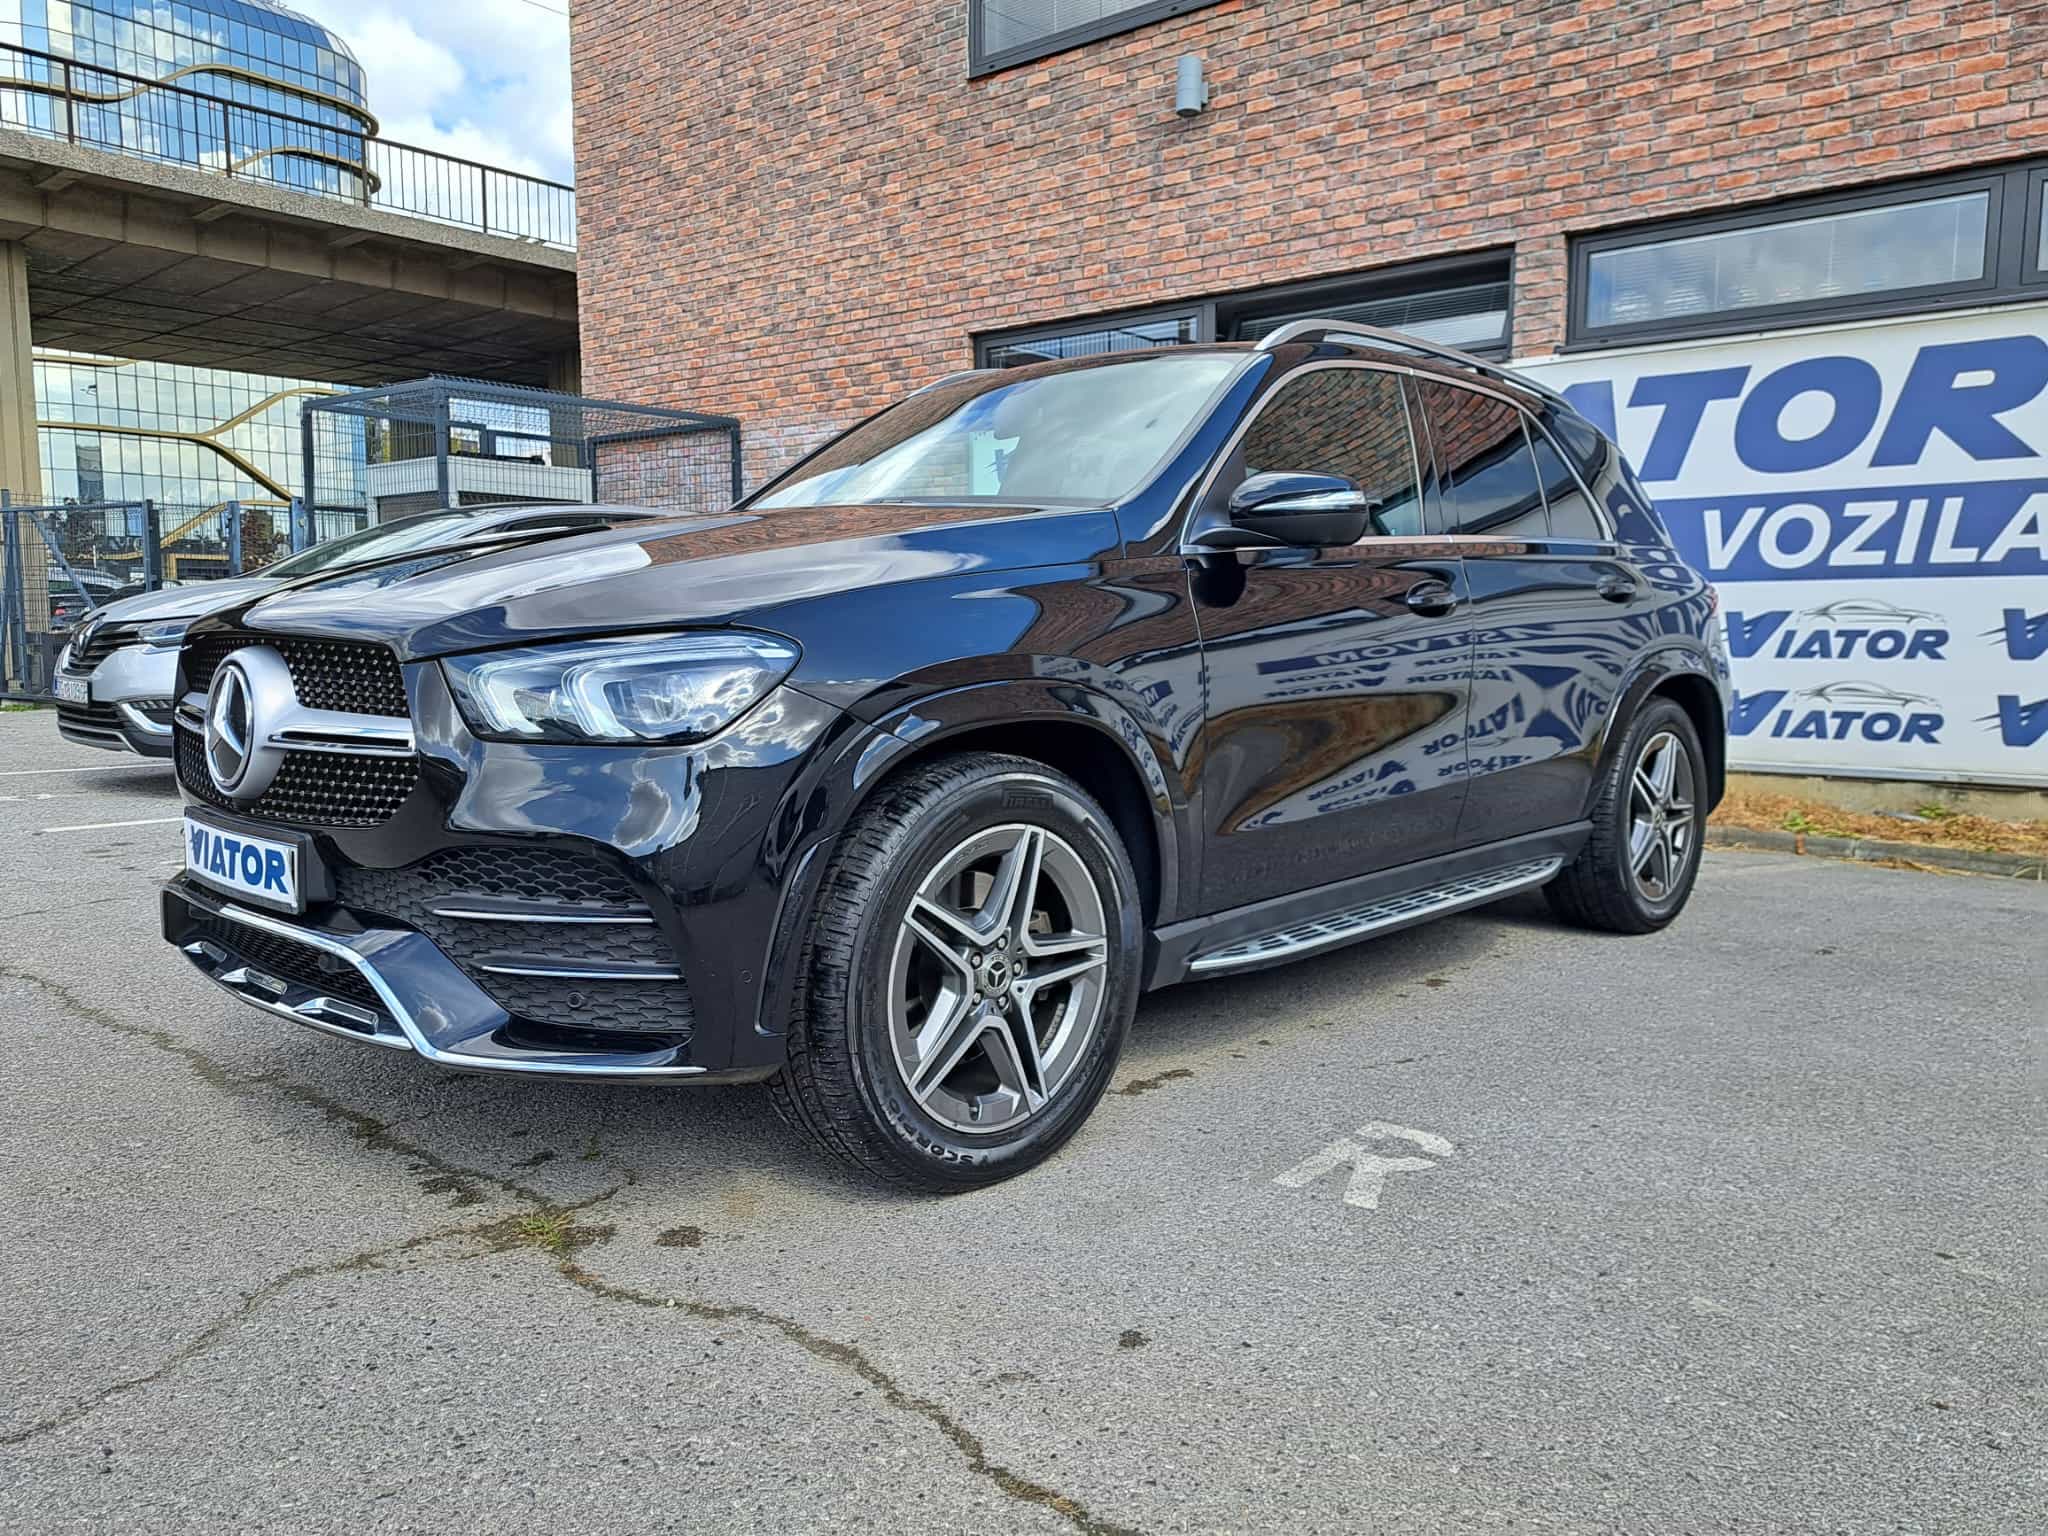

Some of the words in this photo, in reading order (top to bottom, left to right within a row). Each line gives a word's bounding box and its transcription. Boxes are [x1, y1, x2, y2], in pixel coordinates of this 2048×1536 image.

[1703, 492, 2048, 571] VOZILA
[1724, 609, 1949, 660] VIATOR
[1728, 689, 1945, 744] VIATOR
[189, 825, 288, 894] VIATOR
